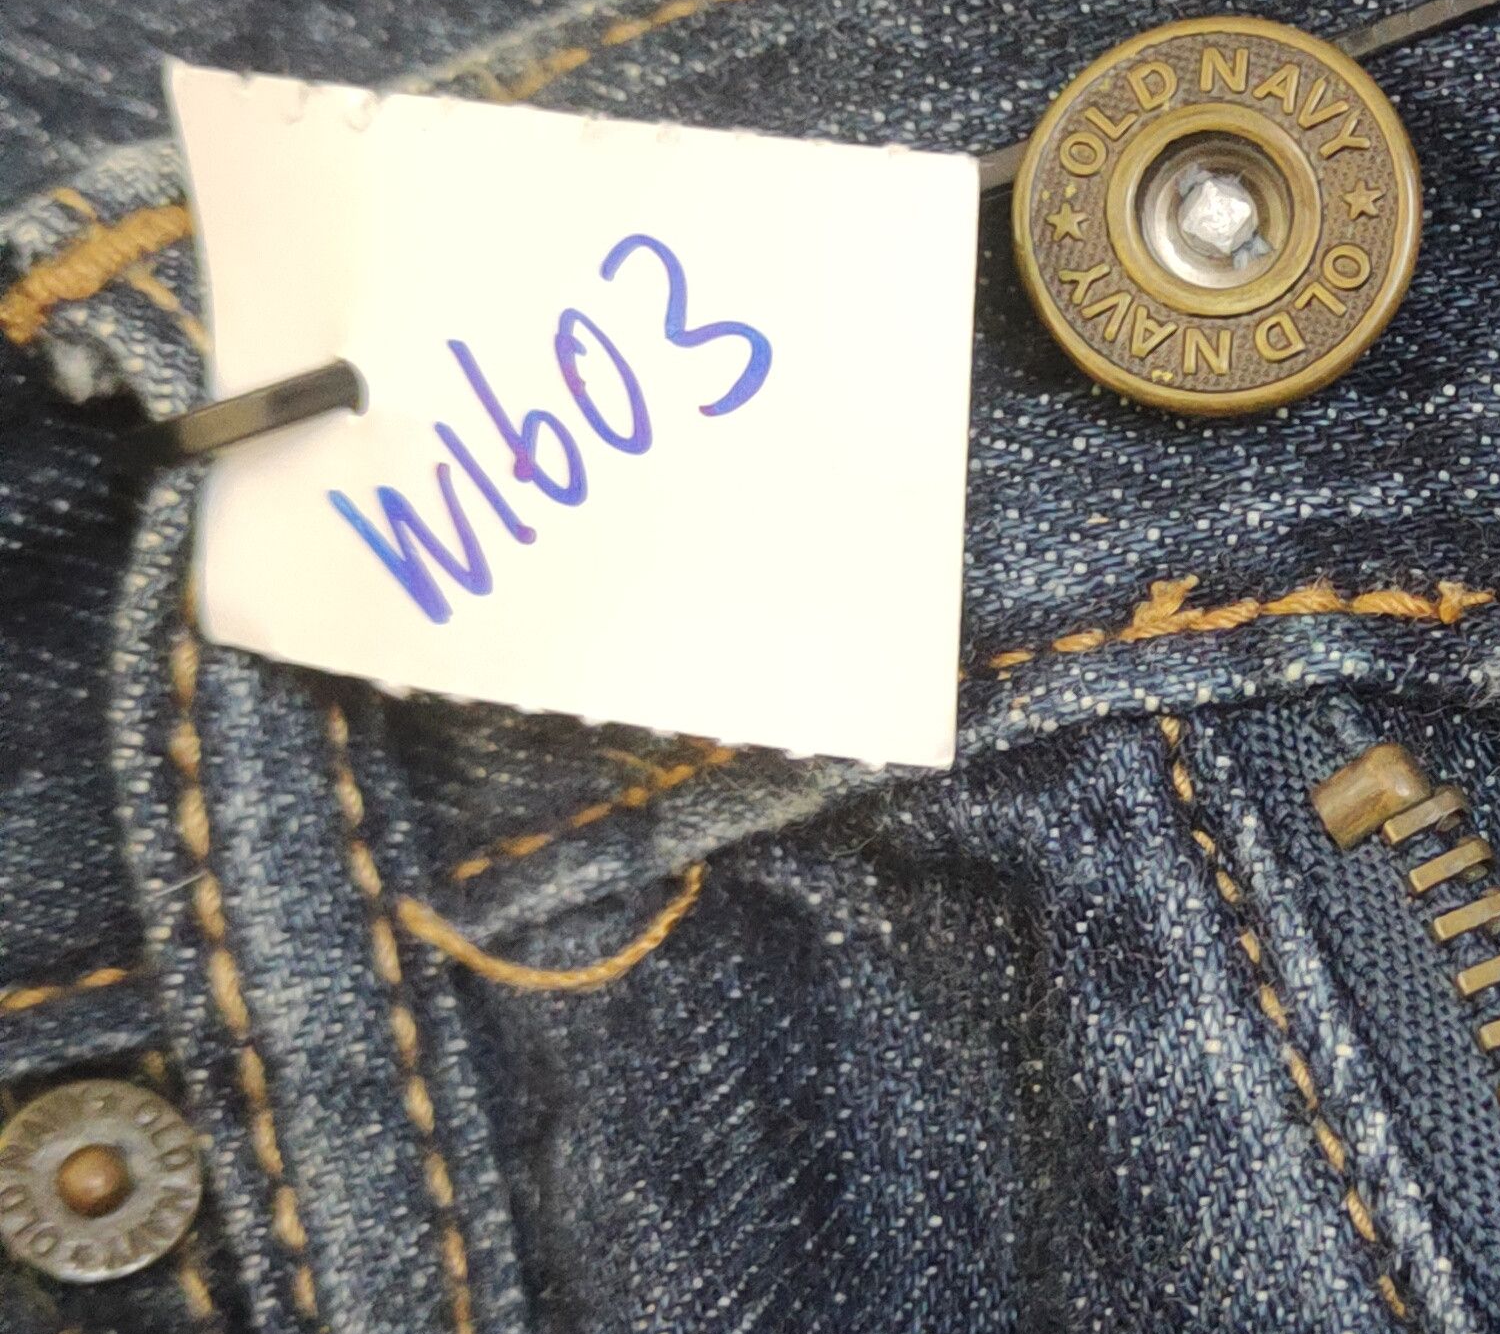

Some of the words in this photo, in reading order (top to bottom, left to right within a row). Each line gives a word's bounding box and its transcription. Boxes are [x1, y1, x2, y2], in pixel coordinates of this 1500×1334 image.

[1059, 60, 1179, 177] OLD
[1199, 47, 1371, 160] NAVY
[1058, 263, 1233, 376] NAVY
[1254, 244, 1371, 363] OLD
